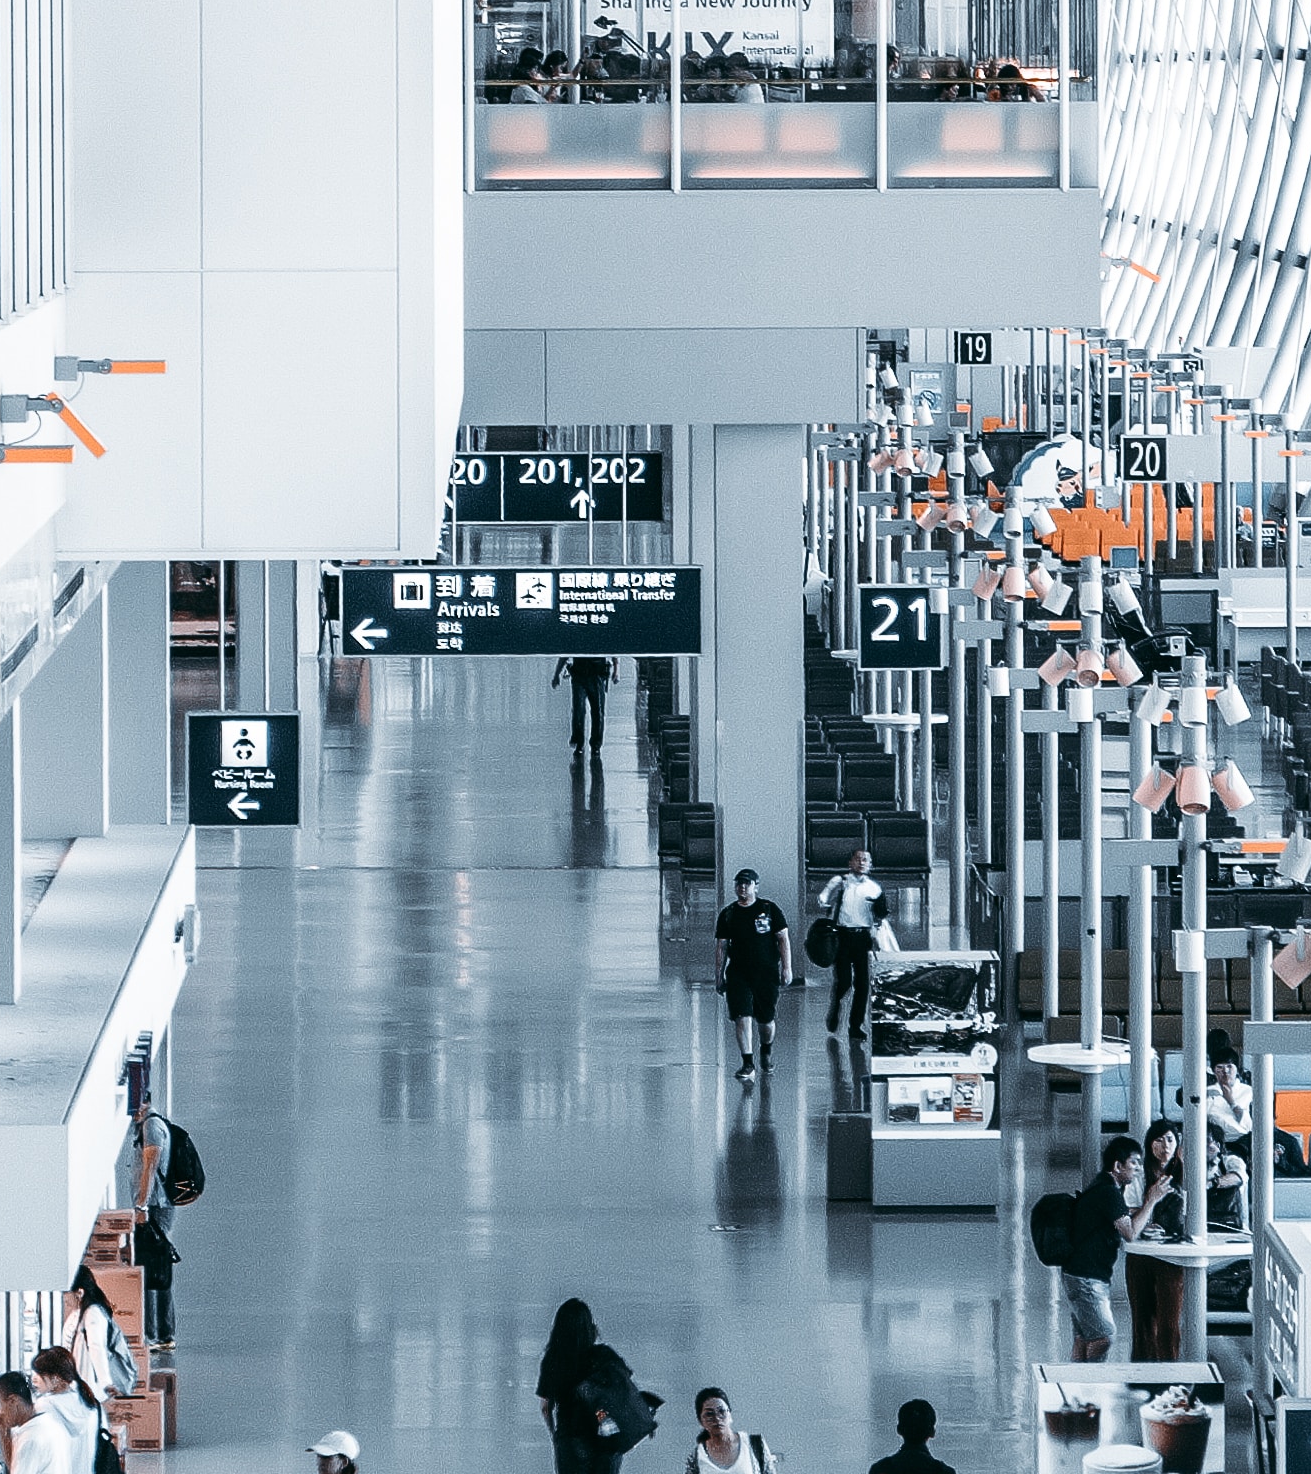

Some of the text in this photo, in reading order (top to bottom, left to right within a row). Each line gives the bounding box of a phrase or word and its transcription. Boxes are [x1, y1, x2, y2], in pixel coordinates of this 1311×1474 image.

[743, 45, 813, 56] Internatioal
[965, 336, 987, 362] 19
[591, 458, 646, 484] 202
[1130, 442, 1161, 477] 20
[559, 589, 676, 600] International Transfer
[437, 601, 500, 618] Arrivals
[871, 598, 927, 641] 21
